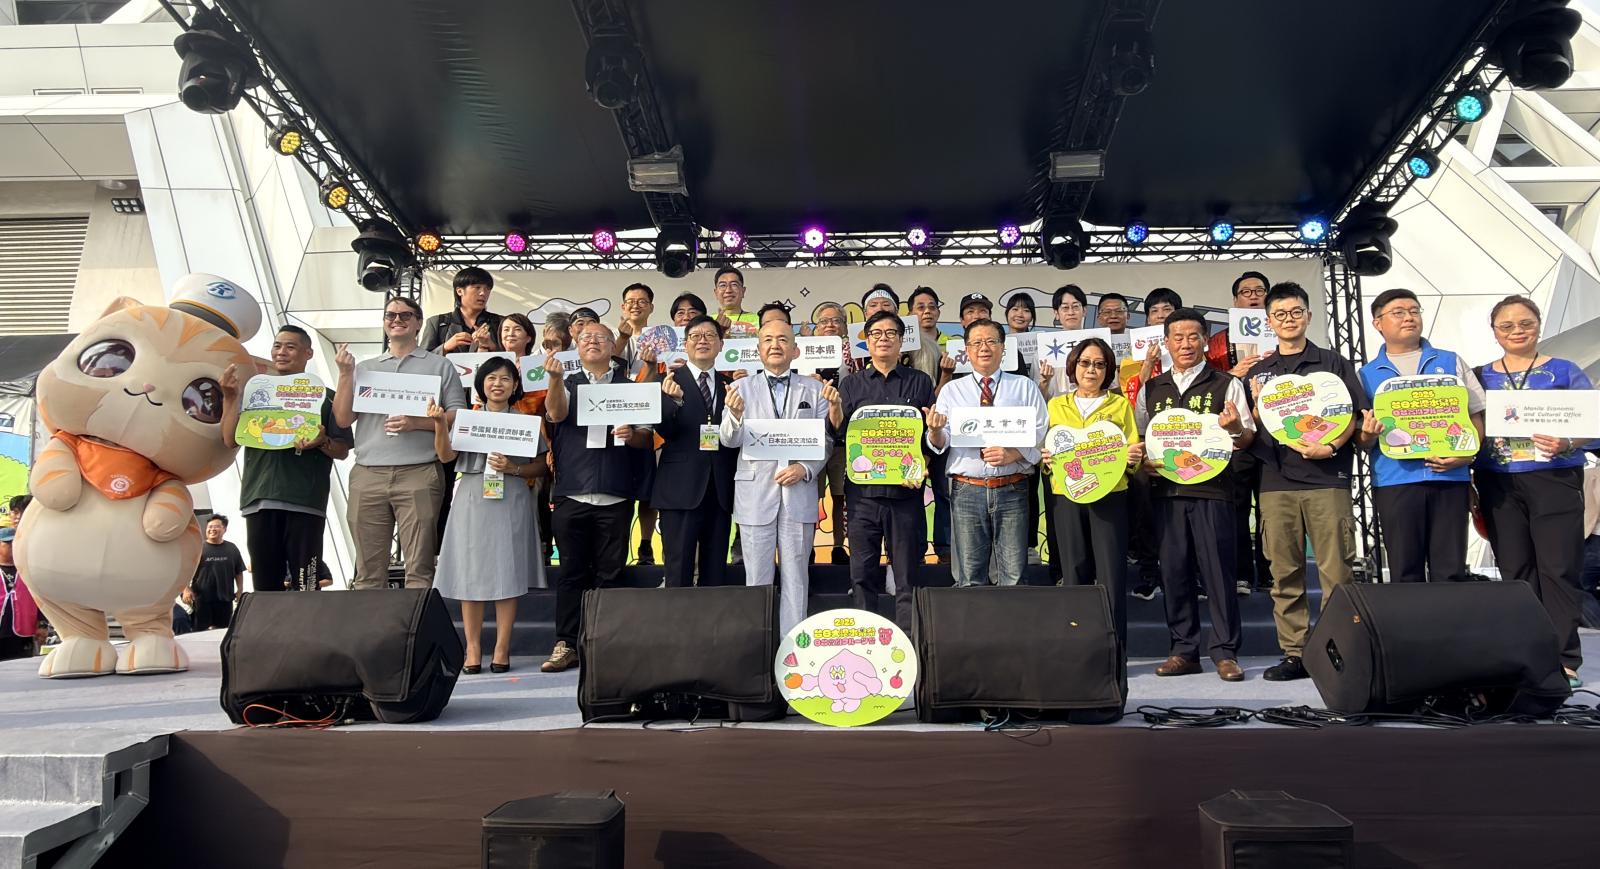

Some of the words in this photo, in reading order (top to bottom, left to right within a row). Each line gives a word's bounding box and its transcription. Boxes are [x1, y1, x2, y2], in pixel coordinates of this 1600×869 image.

[741, 348, 760, 359] 熊本
[805, 344, 835, 355] 熊本県
[563, 359, 582, 371] 重県
[1411, 389, 1436, 398] 2025
[879, 420, 897, 428] 2025
[983, 418, 1027, 429] 農業部
[471, 425, 532, 437] 泰國貿易經濟辦事處
[1087, 430, 1105, 440] 2025
[834, 617, 856, 627] 2025
